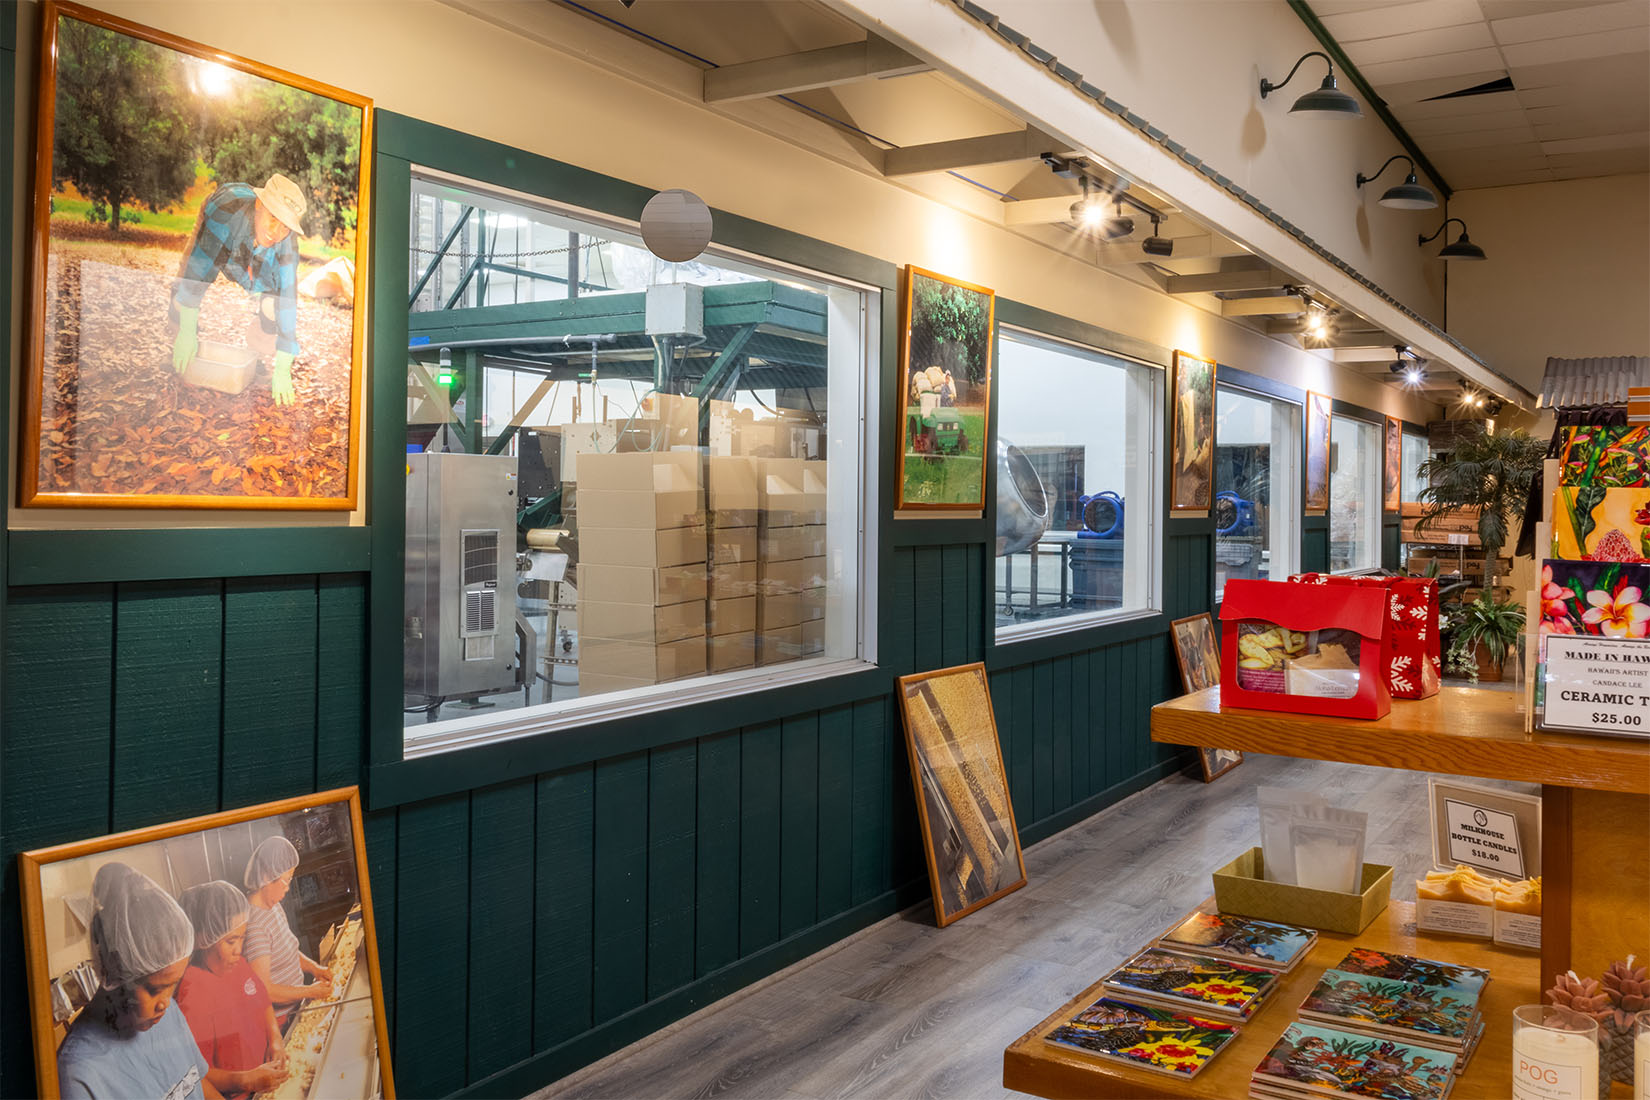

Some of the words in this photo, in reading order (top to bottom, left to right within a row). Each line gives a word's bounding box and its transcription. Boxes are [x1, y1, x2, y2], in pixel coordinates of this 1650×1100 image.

[1565, 651, 1601, 660] MADE
[1605, 653, 1618, 661] IN
[1561, 690, 1634, 705] CERAMIC
[1639, 696, 1650, 706] T
[1592, 712, 1641, 726] $25.00
[1460, 823, 1505, 840] MILKHOUSE
[1451, 832, 1482, 845] BOTTLE
[1482, 840, 1518, 855] CANDLES
[1471, 849, 1500, 862] $18.00
[1519, 1060, 1559, 1085] POG
